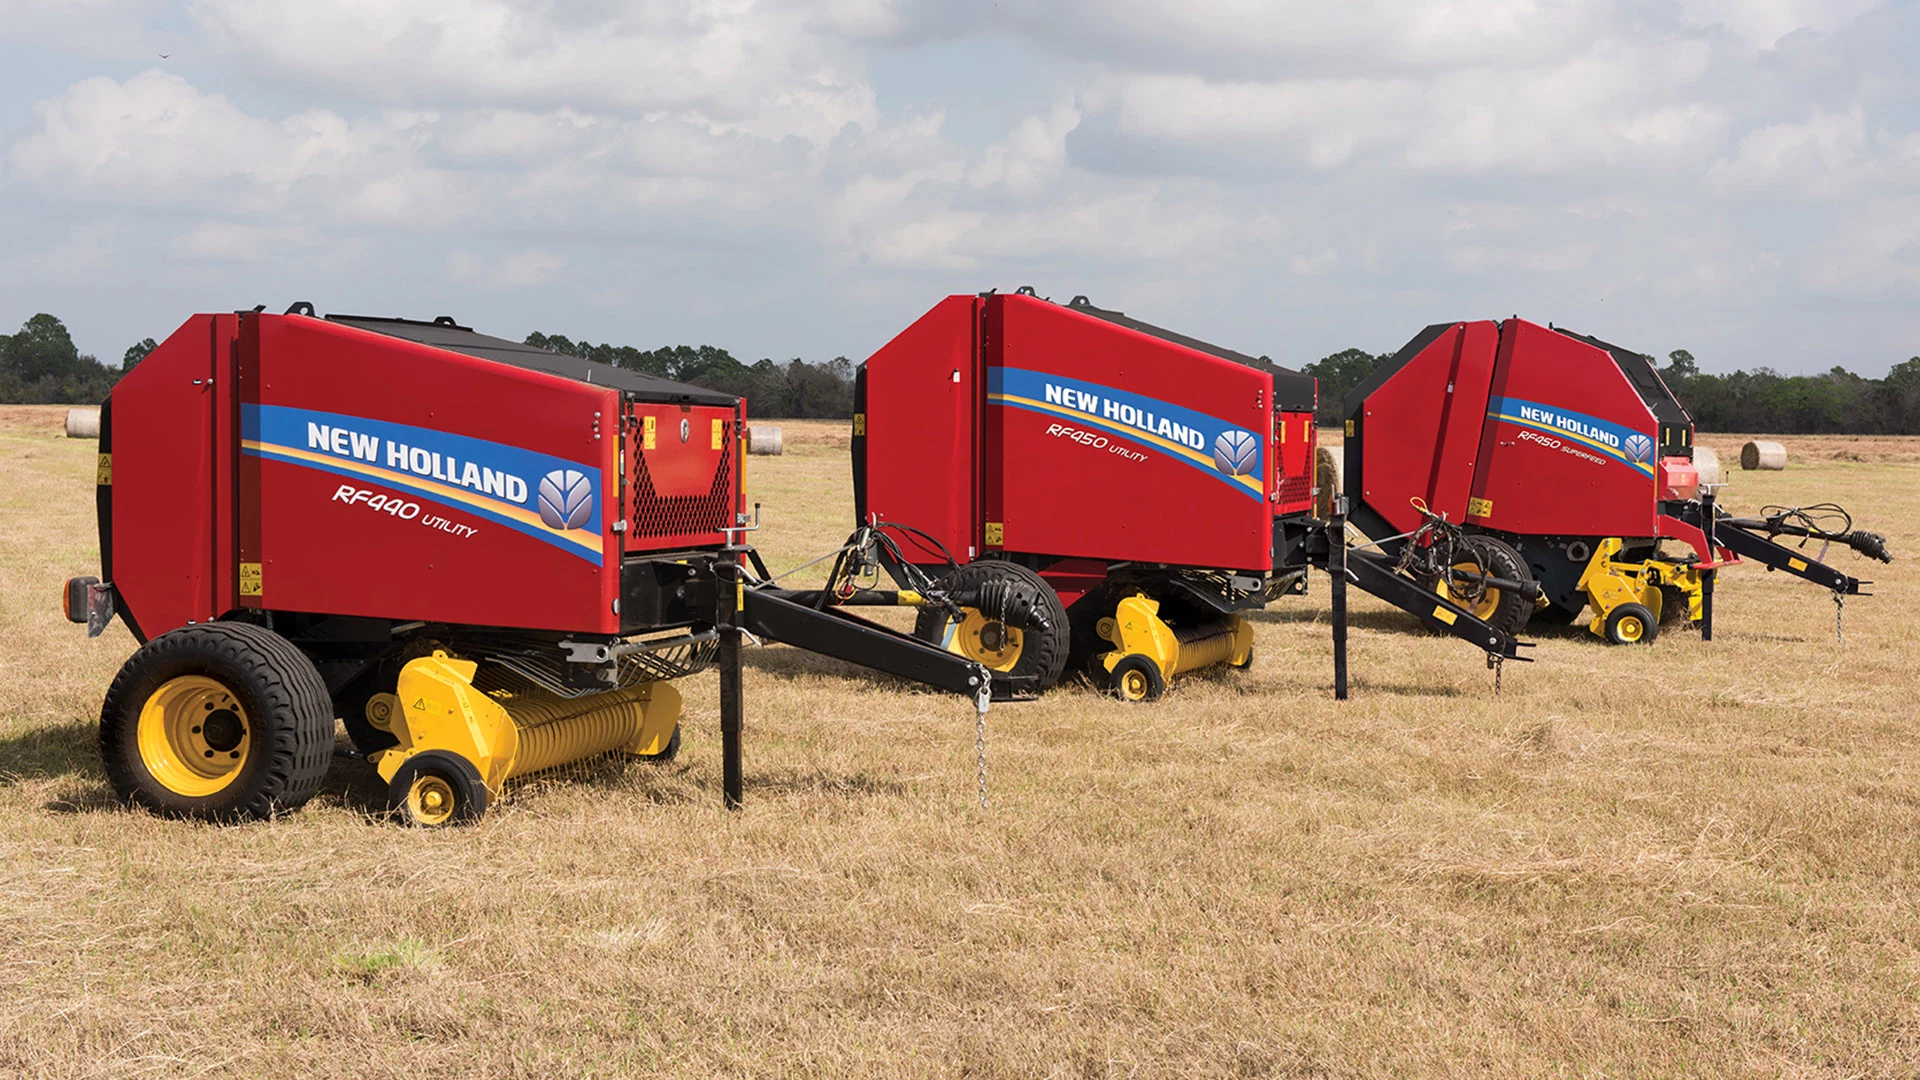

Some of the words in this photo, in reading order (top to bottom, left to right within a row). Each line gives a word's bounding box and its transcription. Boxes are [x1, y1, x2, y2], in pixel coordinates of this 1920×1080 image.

[1045, 383, 1099, 414] NEW
[1103, 398, 1205, 451] HOLLAND
[1520, 405, 1554, 425] NEW
[1556, 415, 1620, 447] HOLLAND
[307, 422, 379, 462] NEW
[387, 440, 528, 504] HOLLAND
[1046, 423, 1108, 449] RF450
[1109, 444, 1148, 463] UTILITY
[1517, 430, 1561, 449] RF450
[1561, 446, 1607, 466] SUPERFEED
[332, 484, 420, 520] RF440
[421, 513, 478, 539] UTILITY
